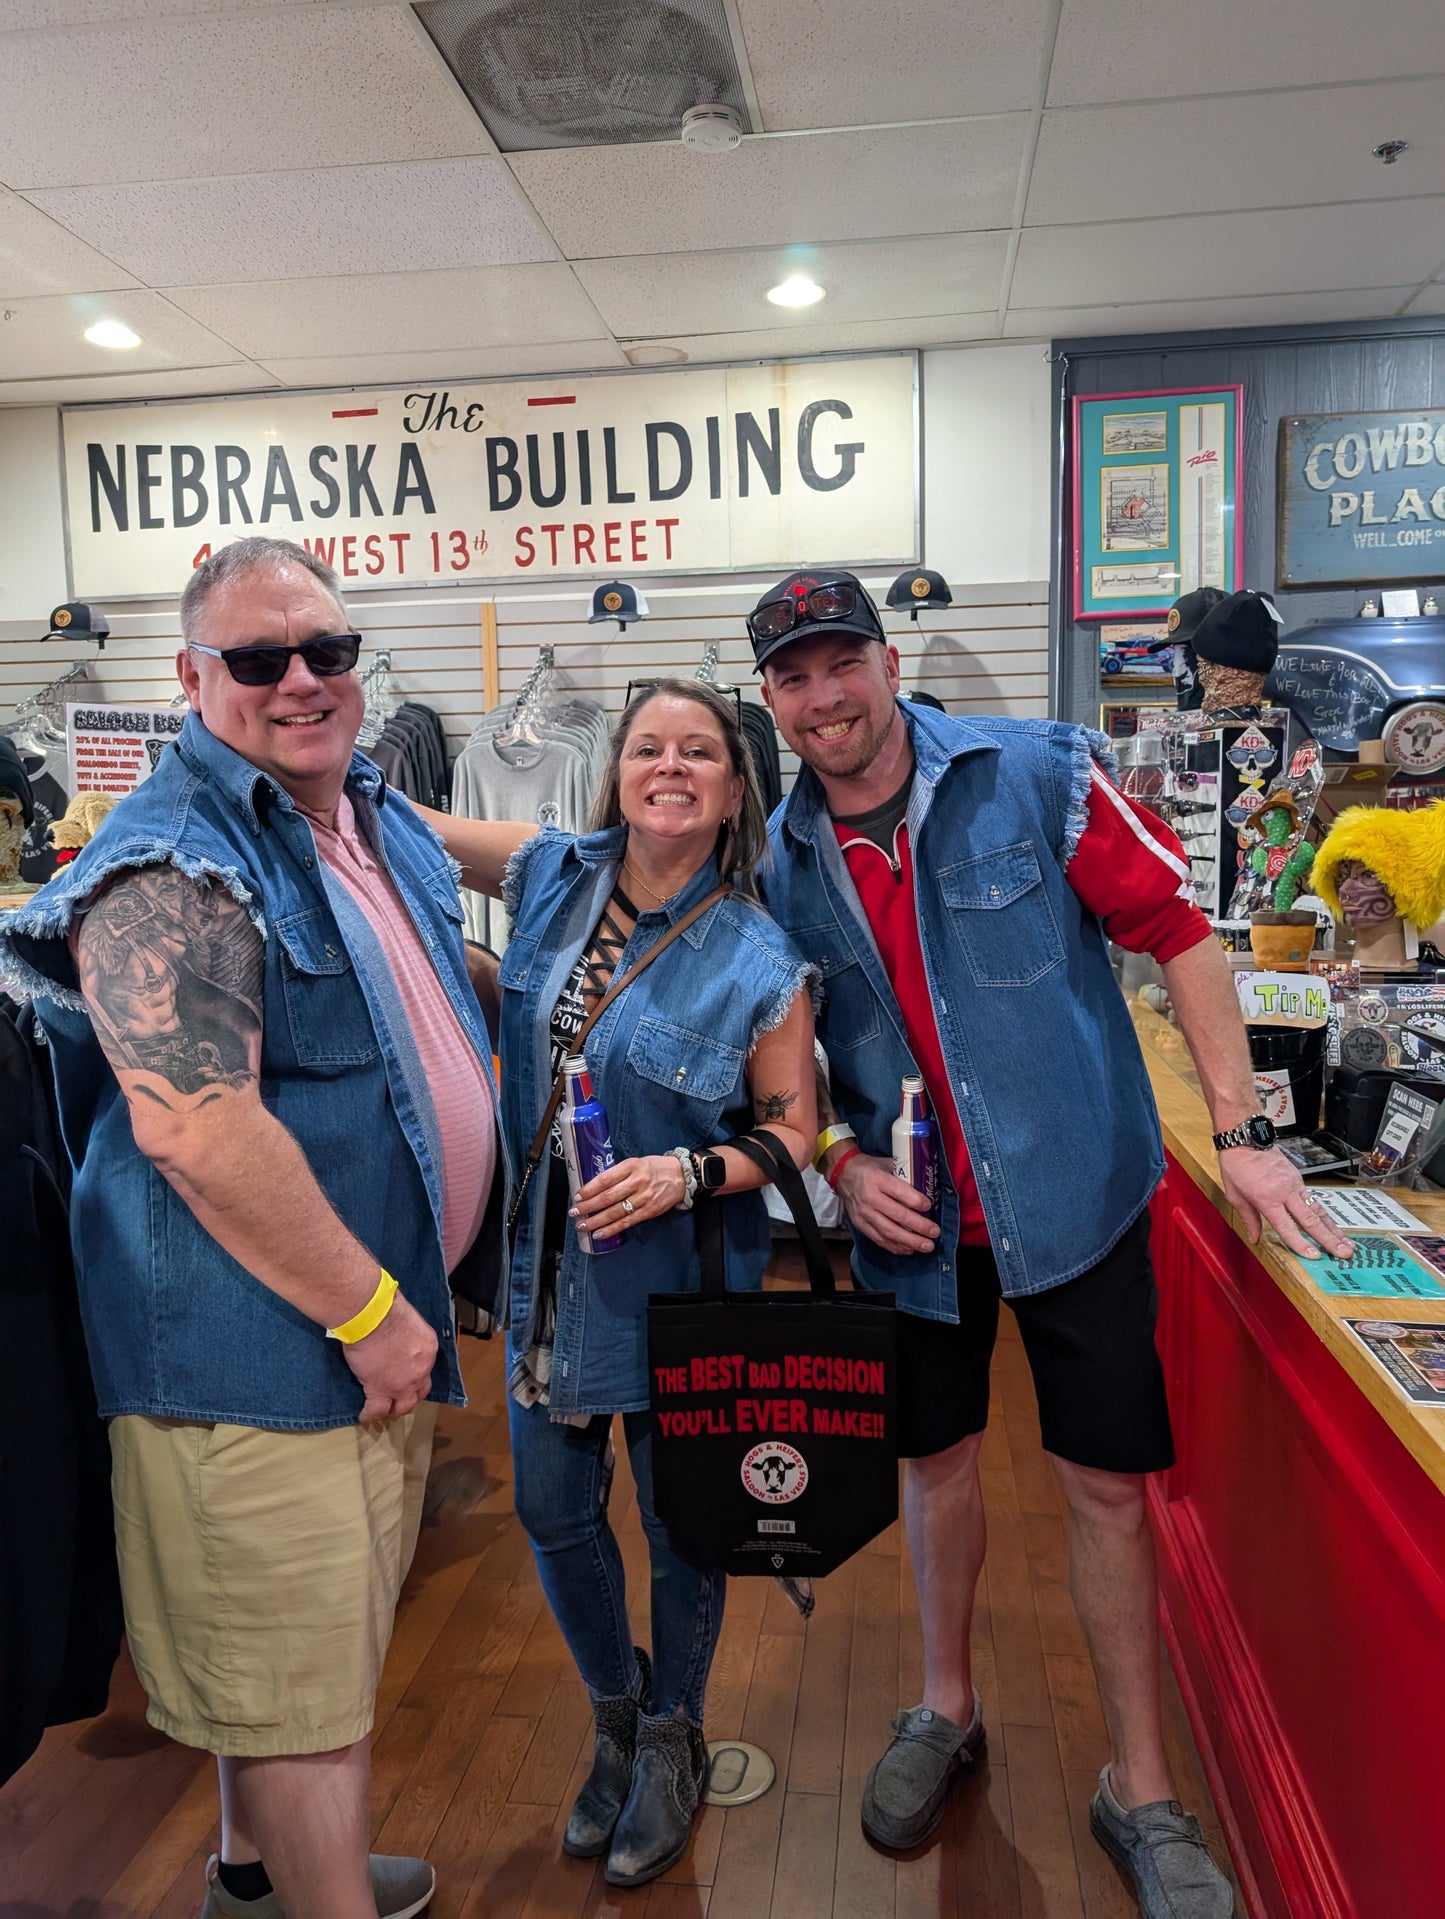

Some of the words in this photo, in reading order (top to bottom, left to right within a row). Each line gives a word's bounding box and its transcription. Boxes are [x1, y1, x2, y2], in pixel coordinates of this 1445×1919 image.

[403, 392, 484, 434] The
[87, 442, 436, 533] NEBRASKA
[486, 399, 865, 512] BUILDING
[305, 533, 410, 577] WEST
[515, 518, 680, 567] STREET
[74, 710, 150, 732] SALOON
[154, 713, 187, 734] DO
[76, 736, 90, 744] 25%
[101, 737, 111, 745] ALL
[95, 749, 106, 757] THE
[108, 749, 121, 757] SALE
[33, 801, 54, 823] EIFER
[25, 847, 41, 858] LAS
[1407, 1012, 1423, 1025] OGS
[1401, 1031, 1420, 1060] SALOON
[1275, 1095, 1287, 1118] VEGAS
[1392, 1088, 1408, 1105] SCAN
[1408, 1095, 1424, 1113] HERE
[655, 1367, 687, 1394] THE
[690, 1355, 744, 1391] BEST
[748, 1362, 781, 1389] BAD
[784, 1355, 885, 1395] DECISION
[658, 1409, 731, 1437] YOU'LL
[736, 1399, 808, 1433] EVER
[813, 1408, 885, 1438] MAKE!!
[776, 1444, 804, 1469] HEIFERS
[743, 1470, 765, 1498] SALOON
[774, 1493, 790, 1501] LAS
[791, 1471, 806, 1495] VEGAS
